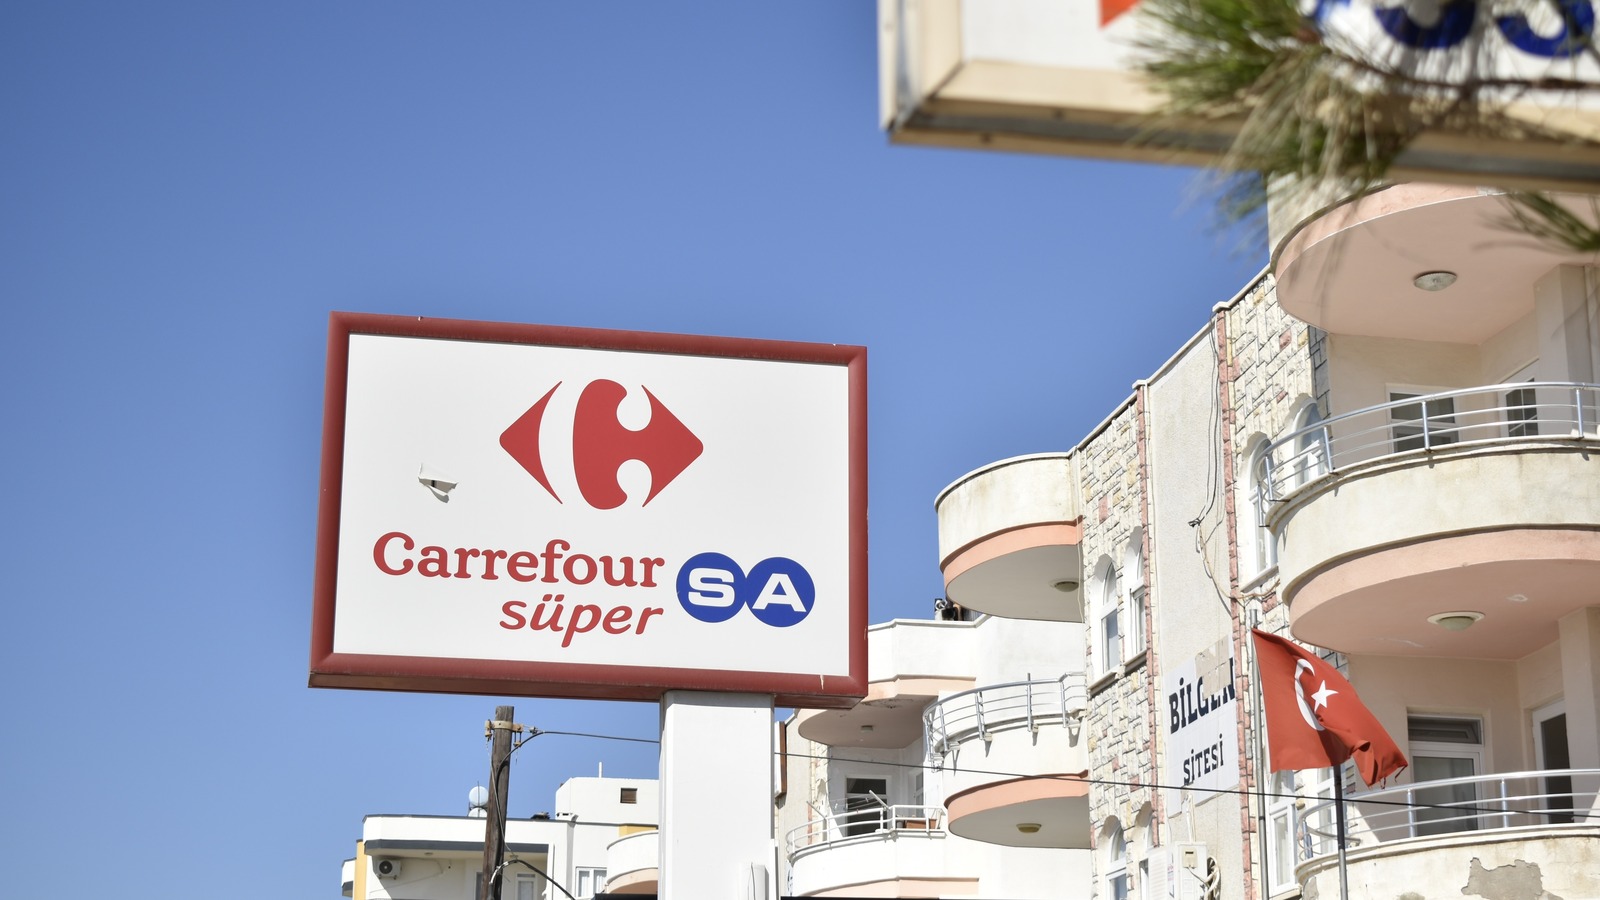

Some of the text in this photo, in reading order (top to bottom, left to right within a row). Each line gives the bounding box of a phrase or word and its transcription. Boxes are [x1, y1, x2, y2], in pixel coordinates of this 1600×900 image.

[373, 532, 807, 613] Carrefour SA
[500, 594, 664, 648] süper
[1183, 733, 1224, 786] SİTESİ
